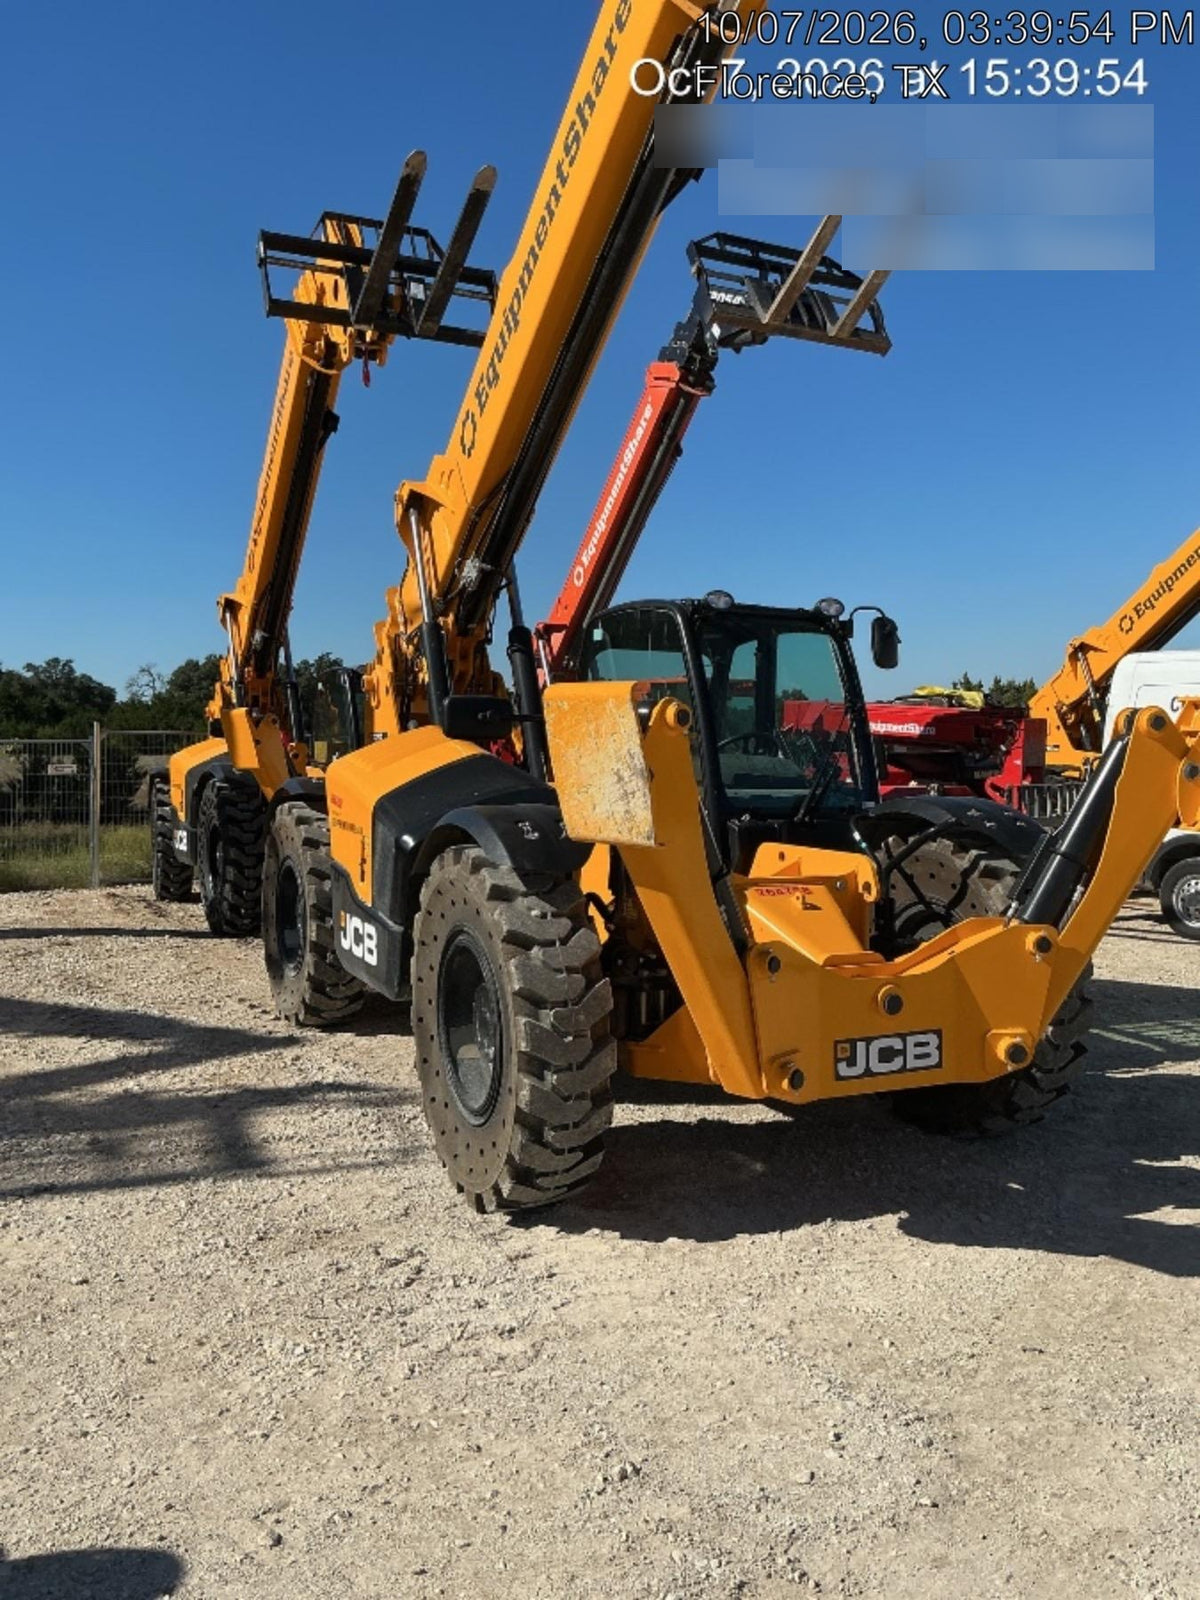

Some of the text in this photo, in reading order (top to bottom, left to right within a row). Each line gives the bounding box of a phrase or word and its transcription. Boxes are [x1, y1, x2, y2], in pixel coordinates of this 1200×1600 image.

[474, 0, 632, 417] EquipmentShare
[581, 403, 654, 567] EquipmentShare
[340, 911, 377, 966] JCB
[837, 1033, 940, 1077] JCB
